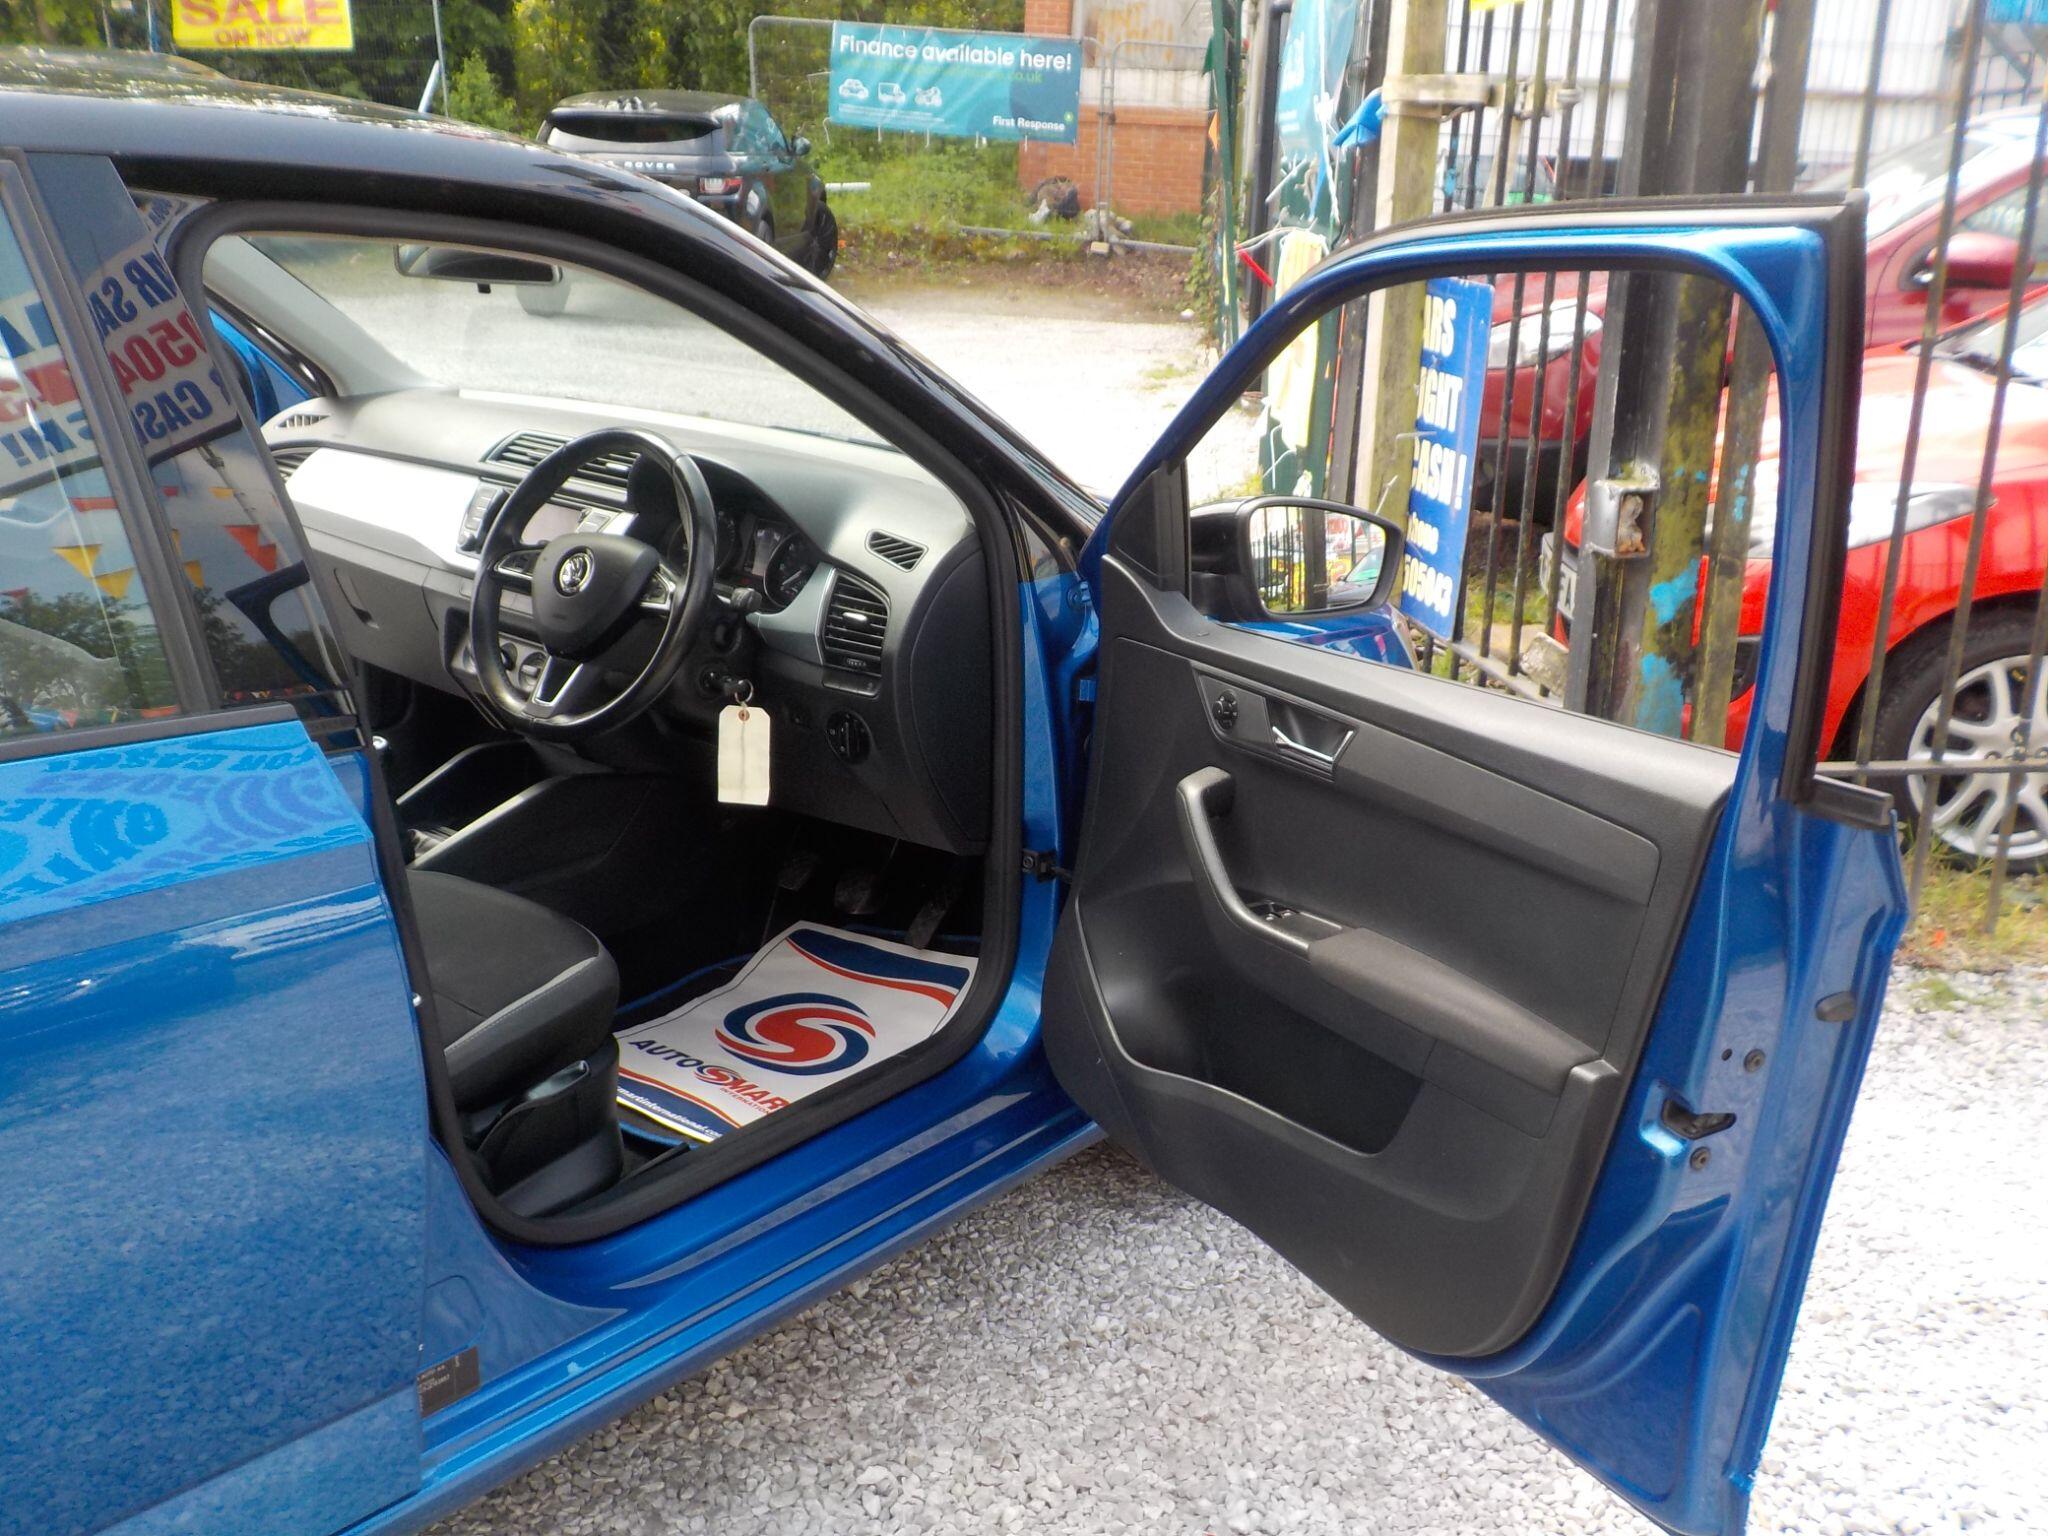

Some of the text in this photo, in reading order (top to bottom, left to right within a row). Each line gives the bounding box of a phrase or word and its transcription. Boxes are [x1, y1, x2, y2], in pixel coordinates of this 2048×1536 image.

[181, 0, 343, 26] SALE
[214, 28, 311, 46] ON NOW
[840, 34, 917, 59] Finance
[922, 43, 1015, 67] available
[1020, 48, 1072, 71] here!
[992, 115, 1066, 131] First Response
